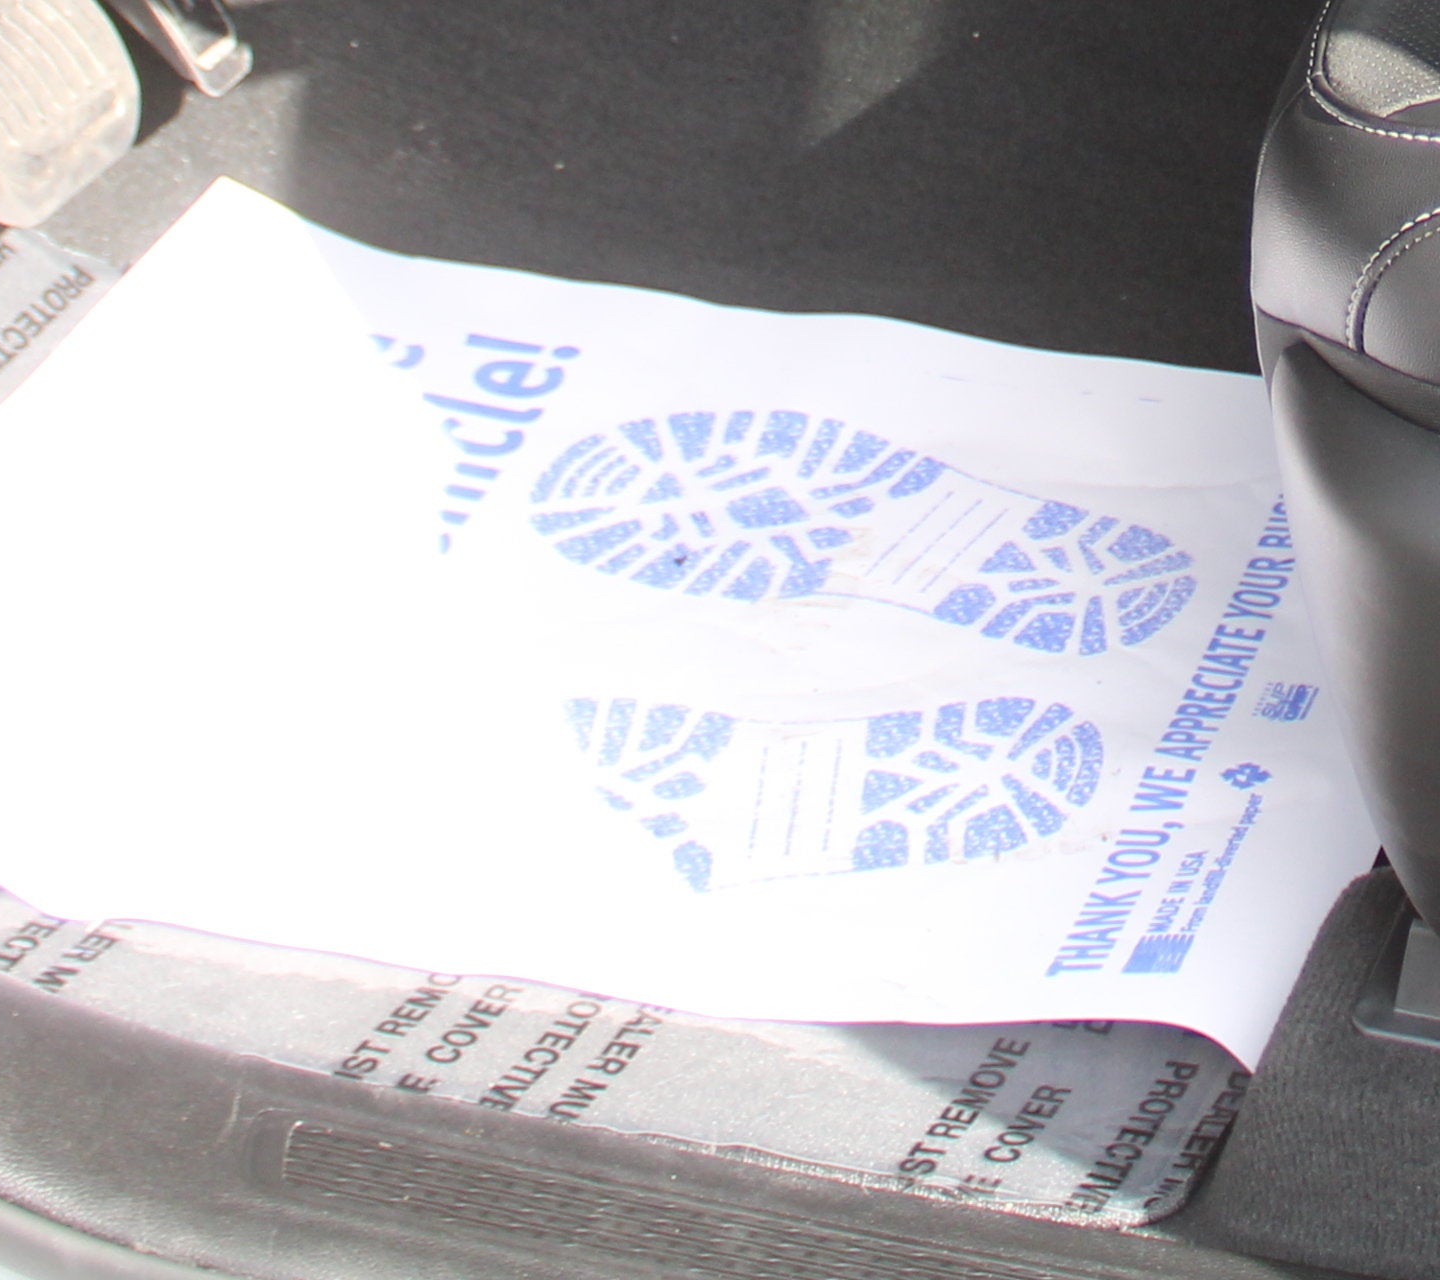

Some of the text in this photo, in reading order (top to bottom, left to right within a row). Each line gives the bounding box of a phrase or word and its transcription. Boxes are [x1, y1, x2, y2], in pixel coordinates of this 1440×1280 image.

[1222, 557, 1297, 620] YOUR
[1154, 623, 1266, 762] APPRECIATE
[1129, 764, 1198, 813] WE
[1096, 821, 1186, 887] YOU,
[1145, 849, 1209, 934] MADE IN USA
[1179, 906, 1208, 933] From
[1239, 792, 1264, 826] paper
[1044, 889, 1144, 978] THANK
[425, 983, 525, 1066] COVER
[925, 1036, 1032, 1141] REMOVE
[983, 1083, 1074, 1164] COVER
